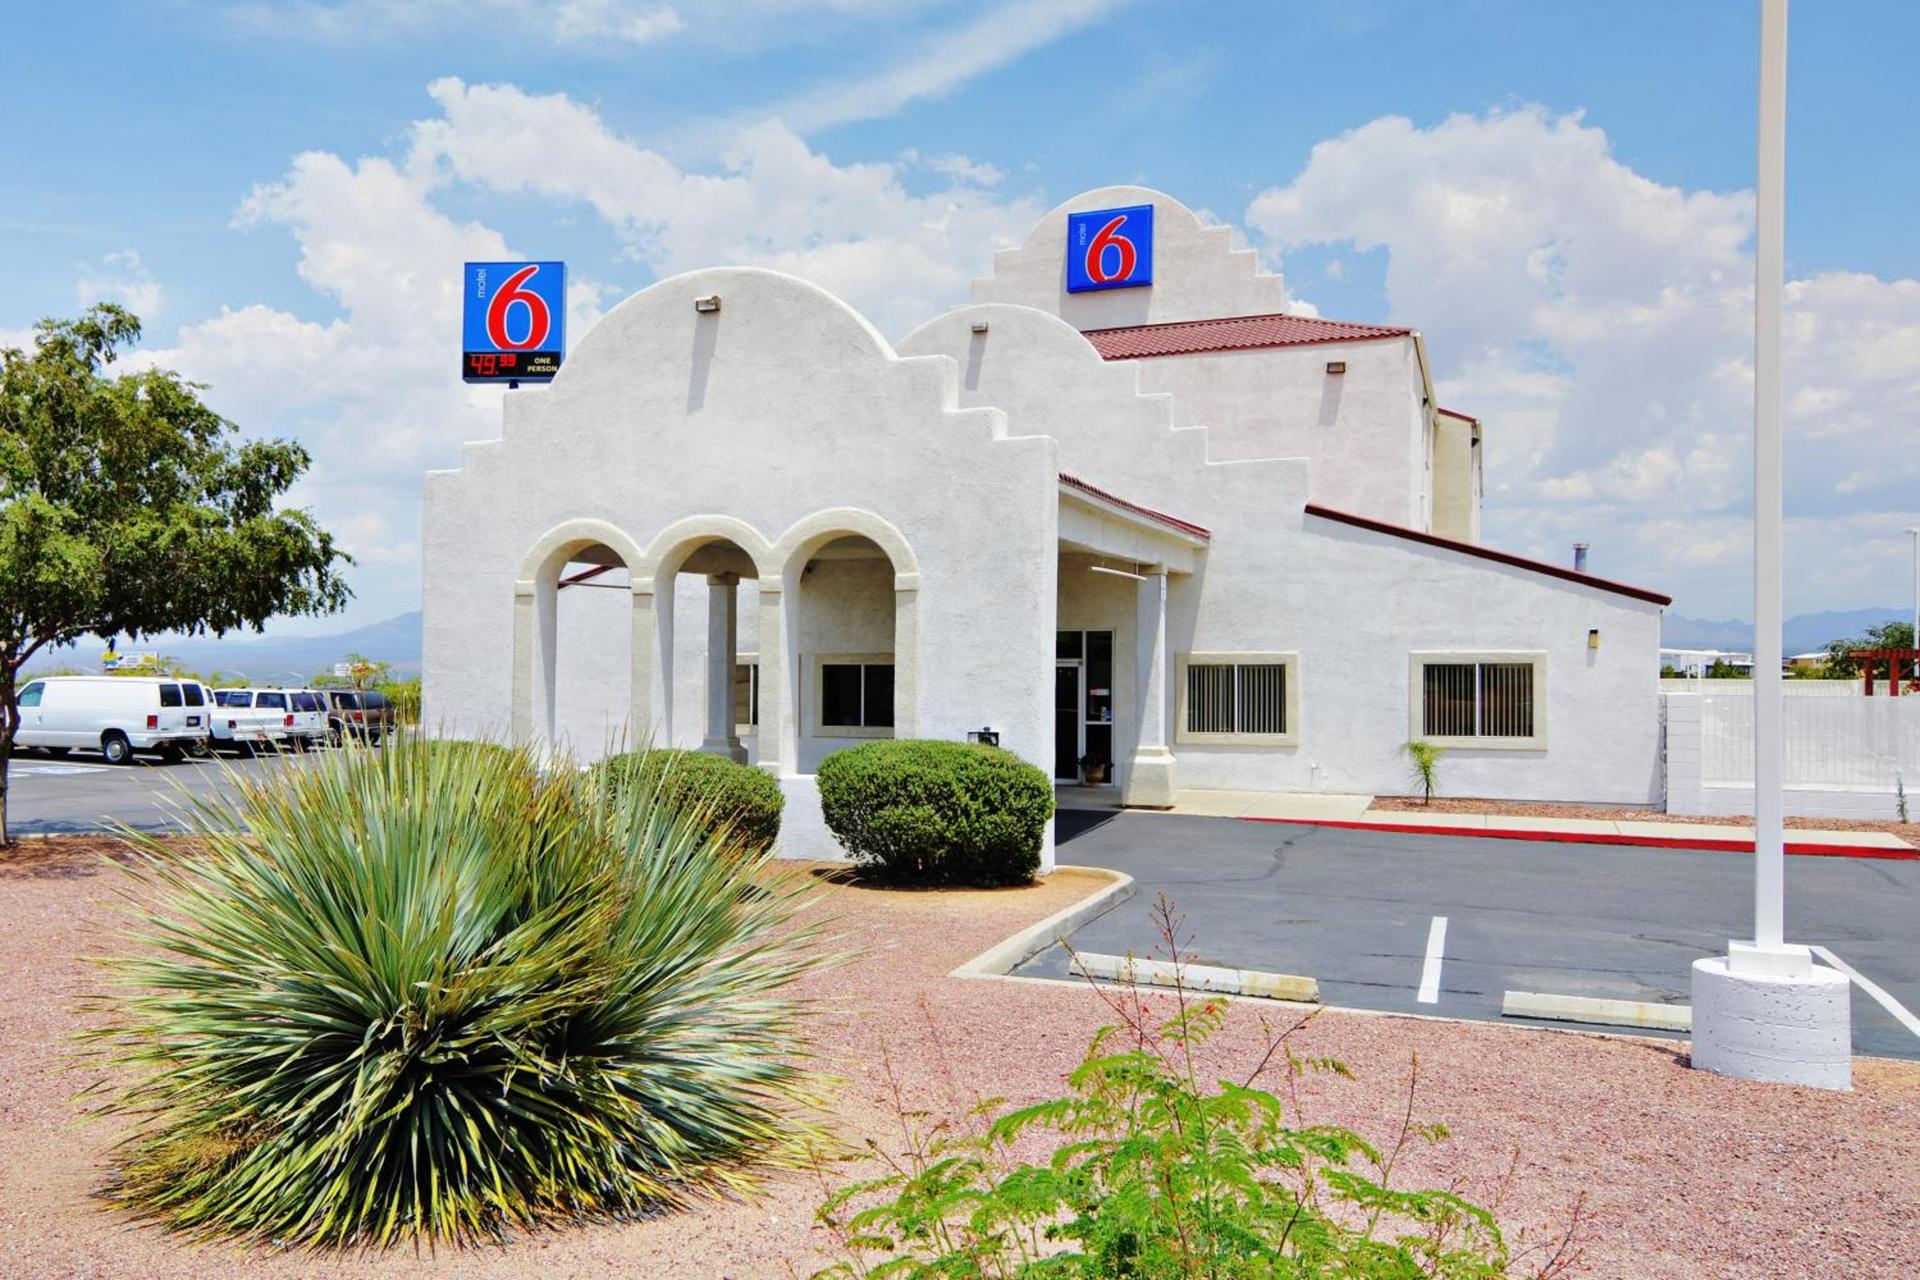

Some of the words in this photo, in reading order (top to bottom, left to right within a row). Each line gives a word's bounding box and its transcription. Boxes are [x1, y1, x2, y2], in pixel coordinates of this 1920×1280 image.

[476, 268, 486, 298] motel
[1085, 215, 1137, 284] 6
[485, 264, 551, 351] 6
